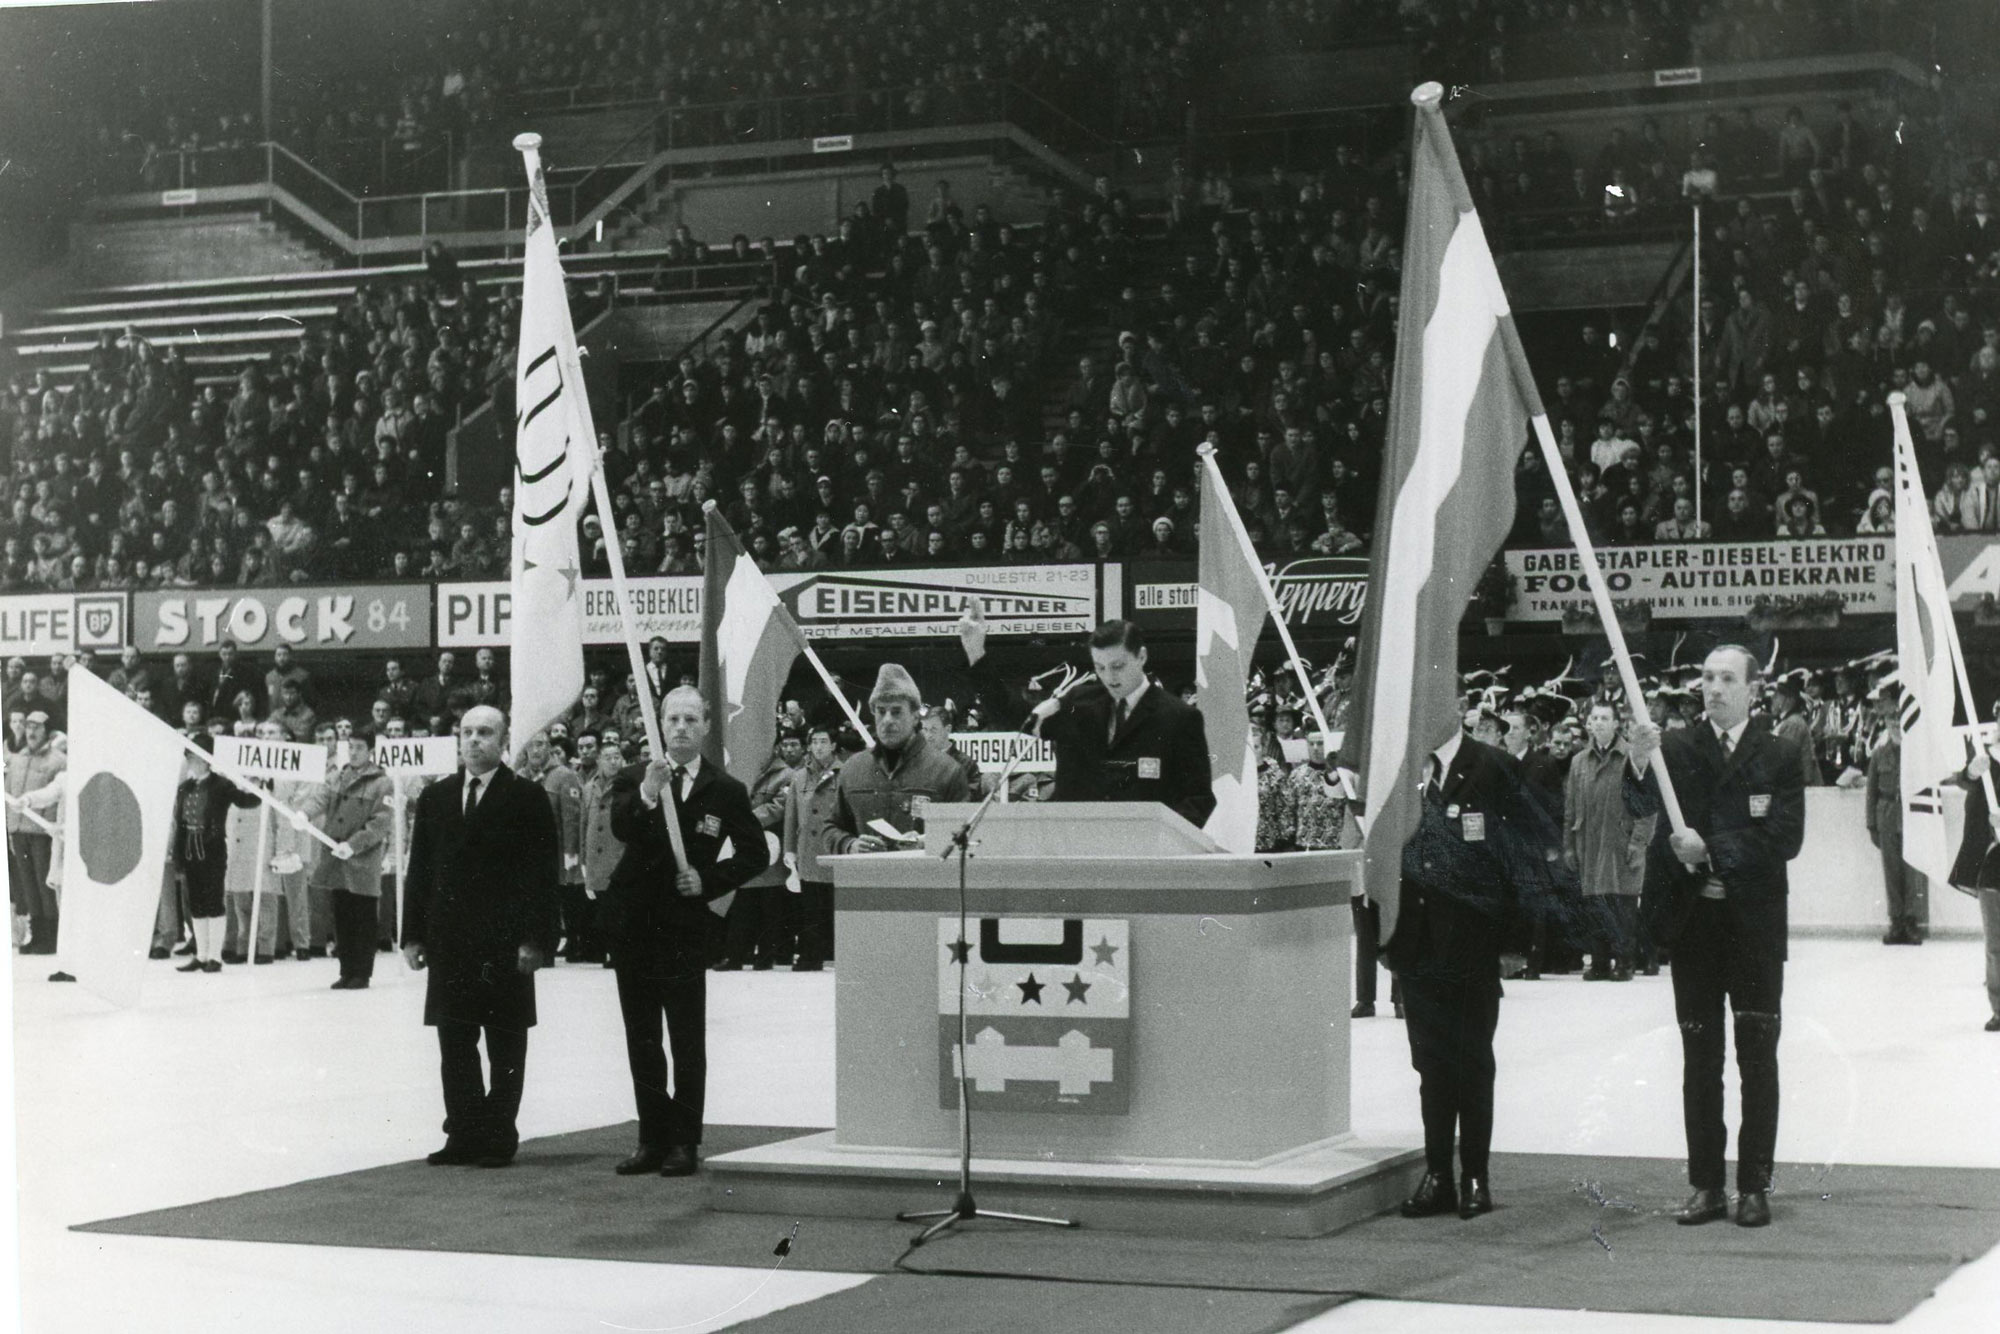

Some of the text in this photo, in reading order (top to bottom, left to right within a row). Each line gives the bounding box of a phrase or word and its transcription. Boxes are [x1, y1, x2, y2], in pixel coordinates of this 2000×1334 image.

[1524, 544, 1886, 572] GABESTAPLER-DIESEL-ELEKTRO
[1660, 566, 1877, 588] AUTOLADEKRANE
[816, 588, 1068, 614] EISENPLATTNER
[1139, 585, 1163, 606] alle
[1, 609, 69, 640] LIFE
[89, 613, 112, 633] BP
[154, 595, 410, 645] STOCK 84
[850, 626, 916, 636] METALLE
[1001, 621, 1087, 632] NEUEISEN
[238, 744, 301, 771] ITALIEN
[951, 739, 1056, 763] UGOSLAWIE
